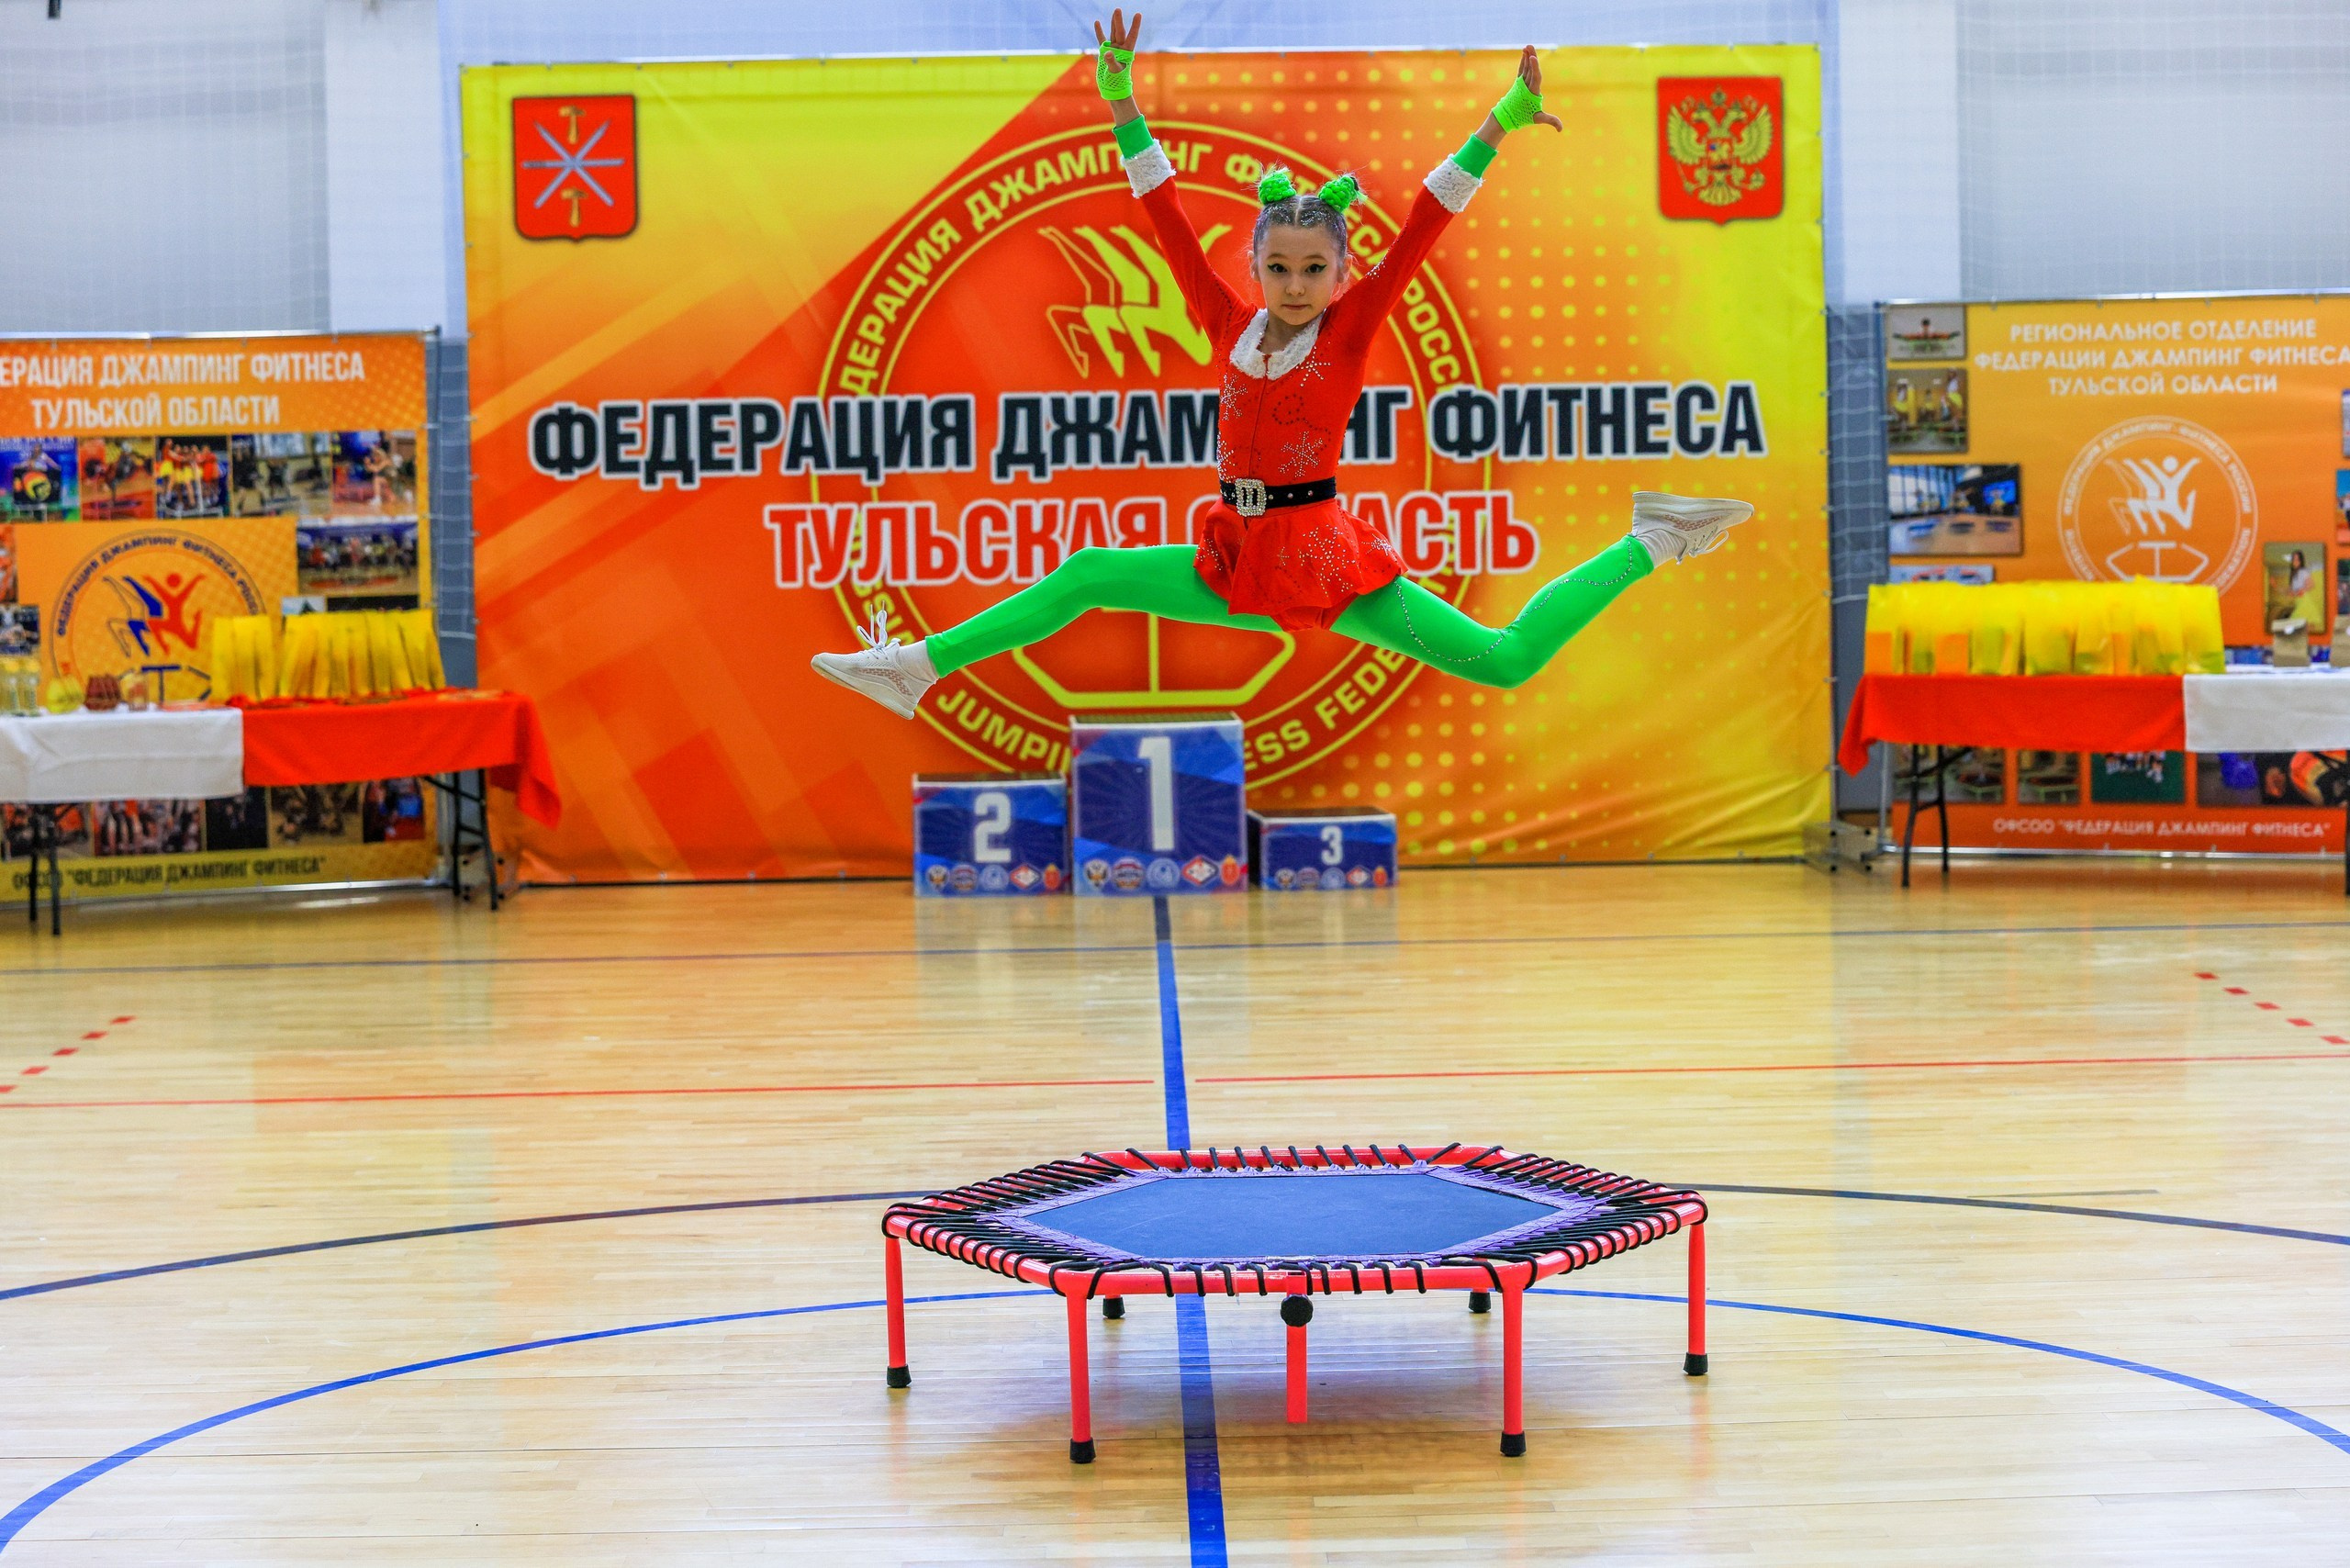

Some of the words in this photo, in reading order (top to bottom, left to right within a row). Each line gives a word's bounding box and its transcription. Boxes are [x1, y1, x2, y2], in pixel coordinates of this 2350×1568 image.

[838, 217, 962, 397] ДЕРАЦИЯ
[965, 140, 1213, 231] ДЖАМПНГ
[1402, 277, 1465, 394] РОСС
[1975, 352, 2106, 373] ФЕДЕРАЦИИ
[2111, 347, 2243, 371] ДЖАМПИНГ
[2249, 345, 2350, 367] ФИТНЕСА
[2010, 320, 2182, 343] РЕГИОНАЛЬНОЕ
[2189, 319, 2317, 341] ОТДЕЛЕНИЕ
[99, 353, 244, 388] ДЖАМПИНГ
[250, 351, 365, 382] ФИТНЕСА
[2049, 373, 2165, 397] ТУЛЬСКОЙ
[2171, 374, 2277, 396] ОБЛАСТИ
[31, 393, 161, 430] ТУЛЬСКОЙ
[169, 395, 280, 427] ОБЛАСТИ
[529, 393, 975, 491] ФЕДЕРАЦИЯ
[990, 384, 1412, 484] ДЖАМНГ
[1427, 380, 1768, 461] ФИТНЕСА
[764, 496, 1168, 591] ТУЛЬСКАЯ
[936, 689, 1072, 774] JUMPI
[974, 791, 1011, 863] 2
[1138, 736, 1176, 852] 1
[1320, 826, 1344, 865] 3
